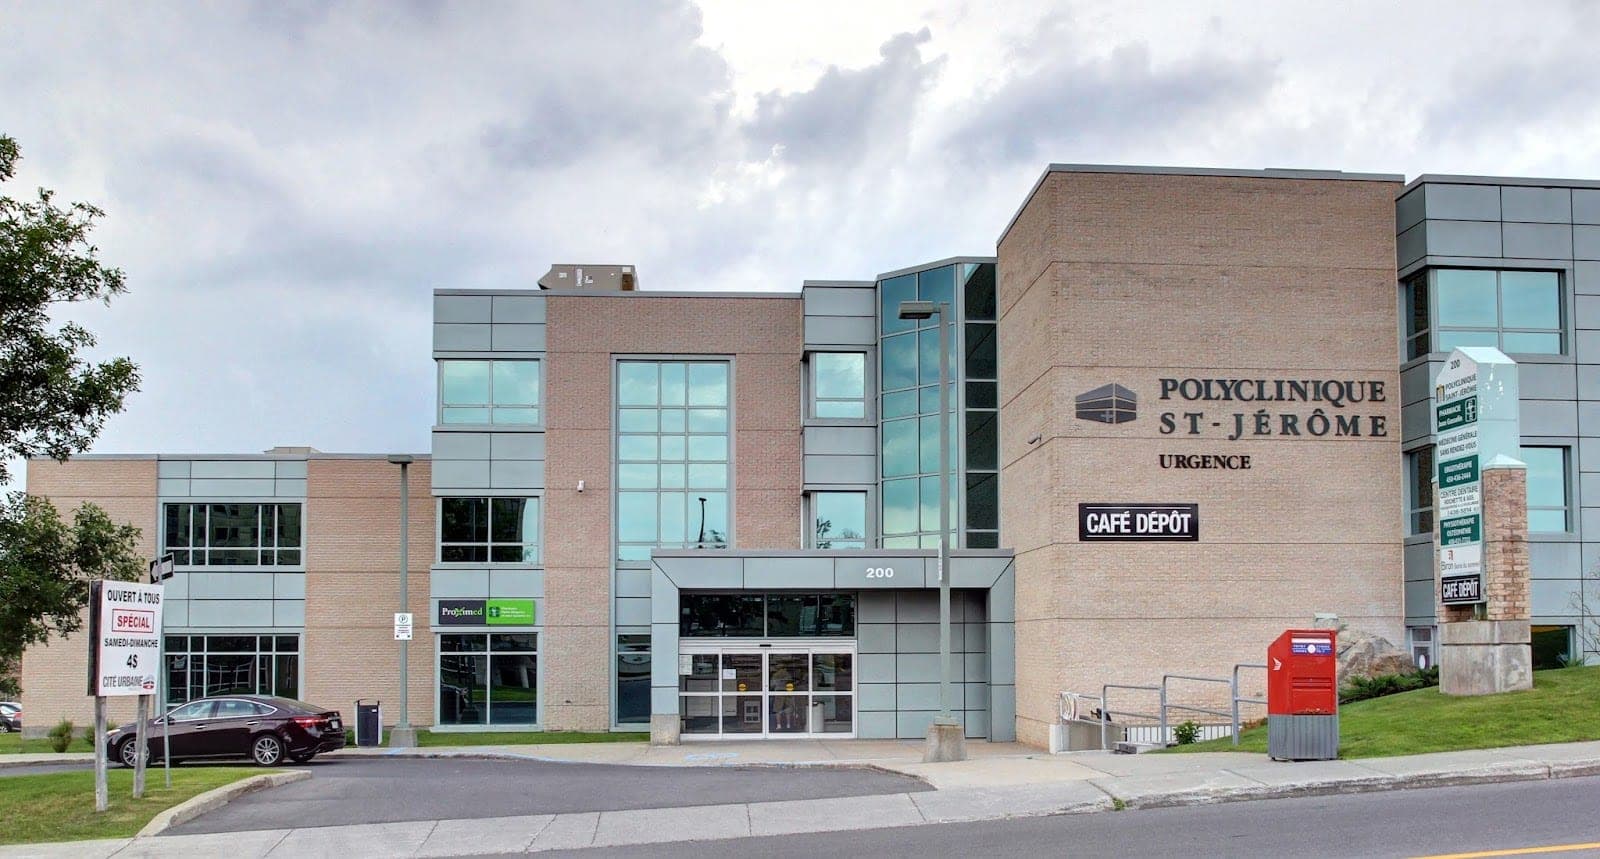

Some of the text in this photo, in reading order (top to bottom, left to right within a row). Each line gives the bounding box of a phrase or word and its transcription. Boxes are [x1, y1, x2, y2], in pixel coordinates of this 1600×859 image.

[1450, 359, 1461, 370] 200
[1445, 373, 1477, 390] POLYCLINIQUE
[1158, 378, 1386, 408] POLYCLINIQUE
[1158, 454, 1251, 470] URGENCE
[1086, 510, 1192, 534] CAFÉ DÉPÔT
[866, 567, 894, 578] 200
[1443, 579, 1479, 598] CAFÉ DÉPÔT
[107, 589, 160, 605] OUVERT À TOUS
[117, 613, 150, 628] SPÉCIAL
[104, 638, 158, 648] SAMEDI-DIMANCHE
[118, 675, 143, 687] URBAINE
